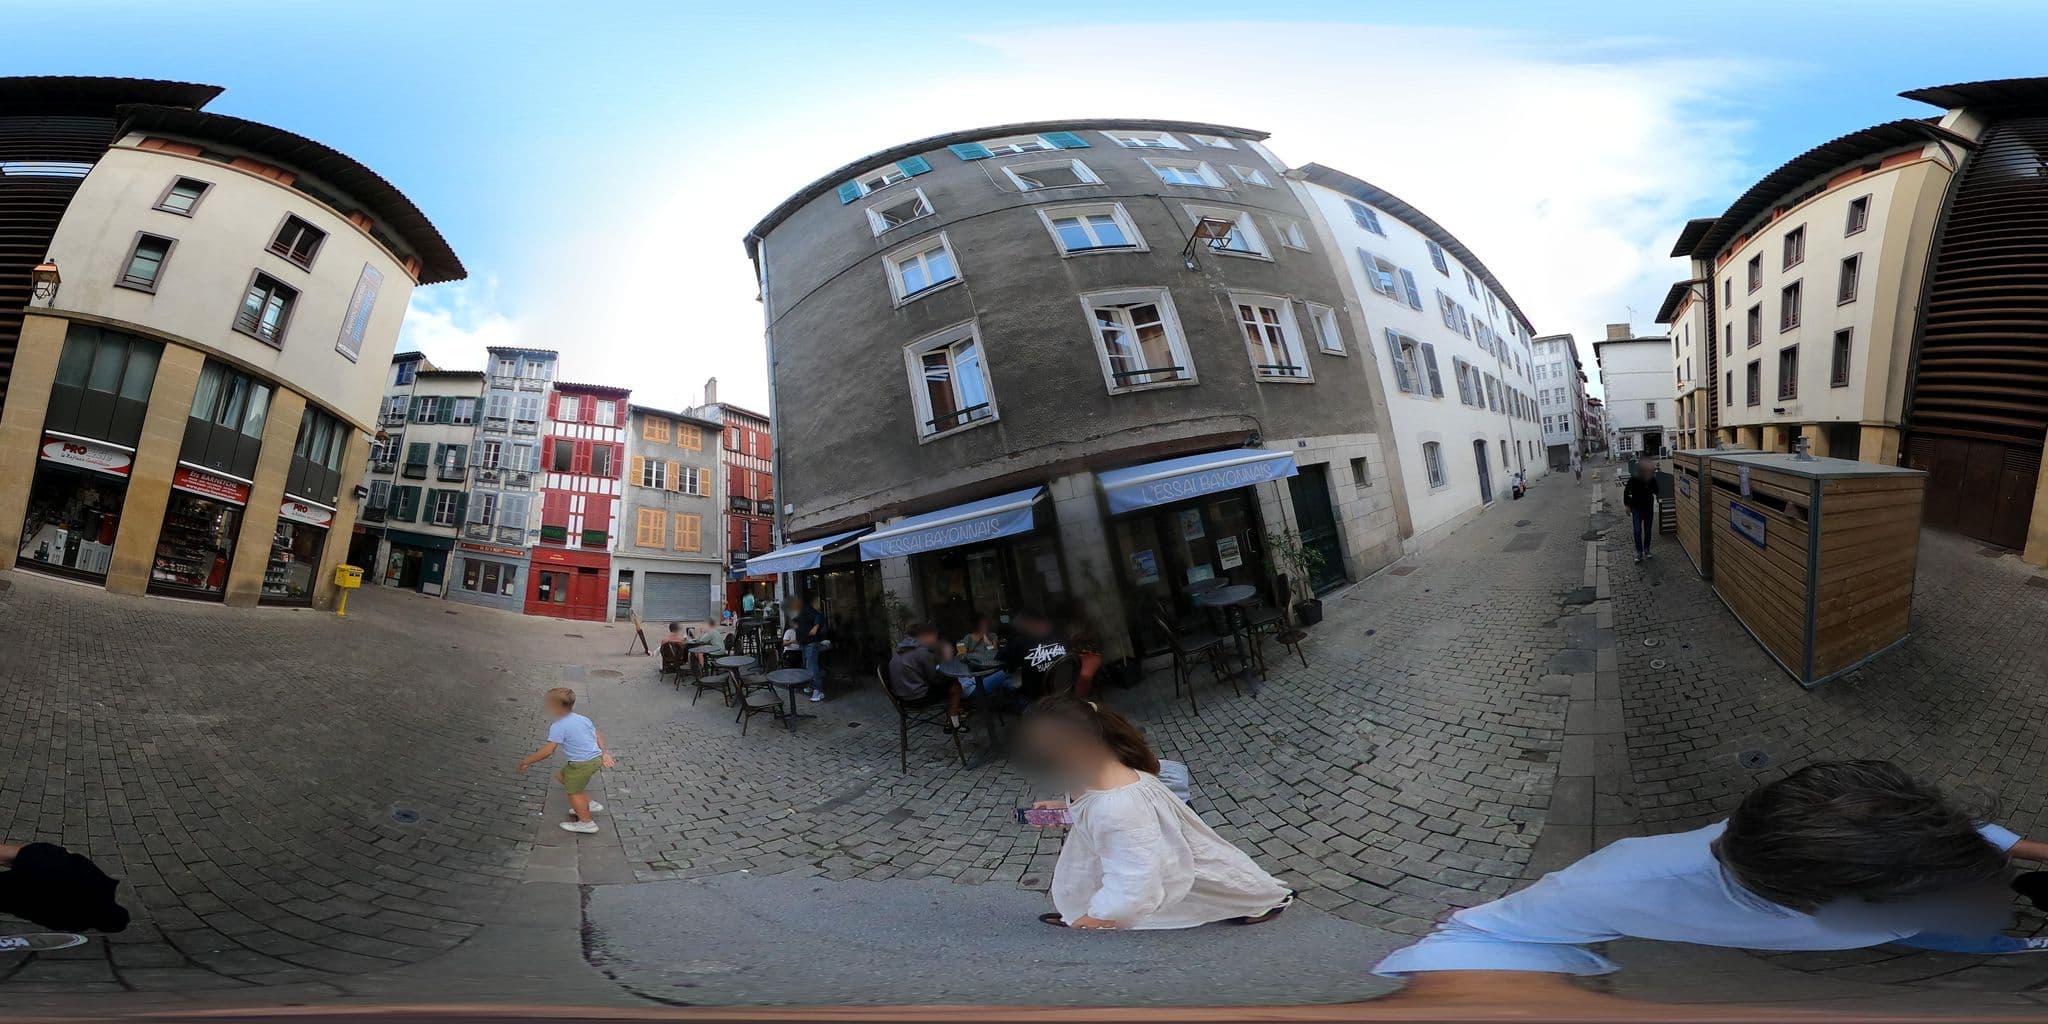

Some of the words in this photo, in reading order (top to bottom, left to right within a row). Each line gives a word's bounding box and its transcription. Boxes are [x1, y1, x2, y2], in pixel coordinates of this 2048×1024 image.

[1141, 478, 1198, 504] L'ESSAI
[1199, 463, 1274, 492] BAYONNAIS
[880, 539, 923, 556] L'ESSAI
[925, 519, 1000, 547] BAYONNAIS
